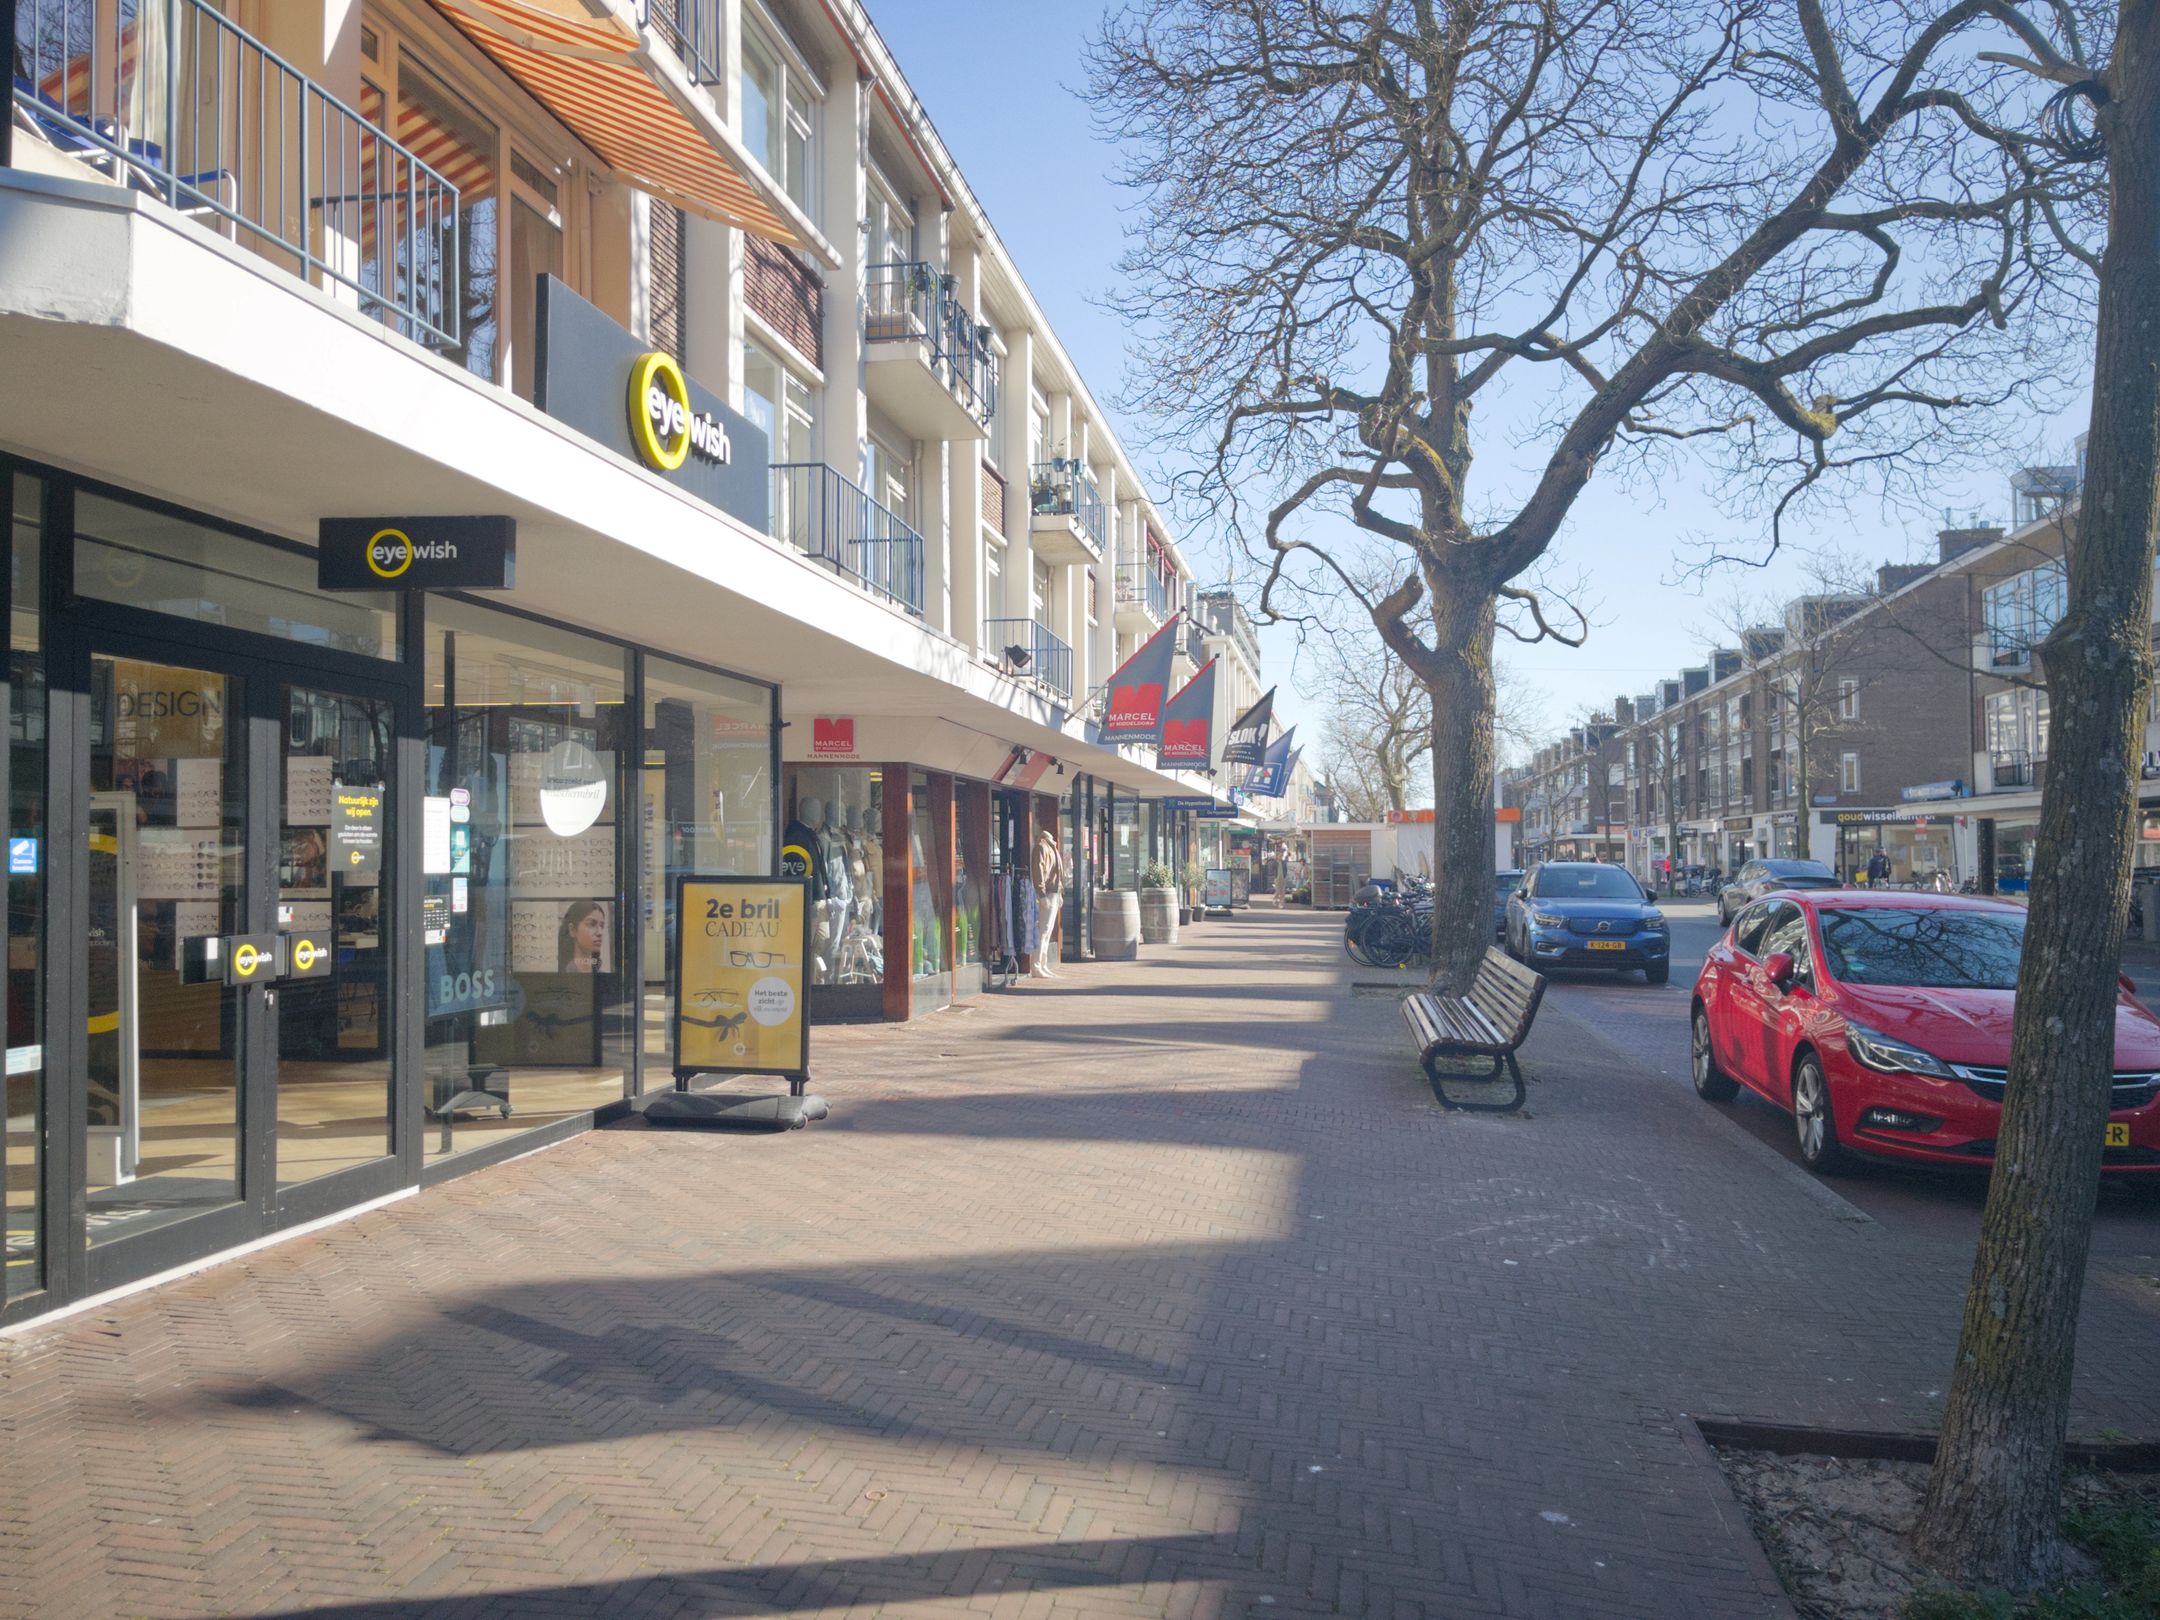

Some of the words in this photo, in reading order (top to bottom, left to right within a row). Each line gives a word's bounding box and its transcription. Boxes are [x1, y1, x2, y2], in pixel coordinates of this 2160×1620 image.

[116, 690, 221, 717] DESIGN
[1109, 712, 1156, 722] MARCEL
[1105, 733, 1157, 741] MANNENMODE
[706, 898, 734, 919] 2e
[741, 898, 779, 919] bril
[705, 921, 779, 937] CADEAU
[440, 969, 495, 1004] BOSS
